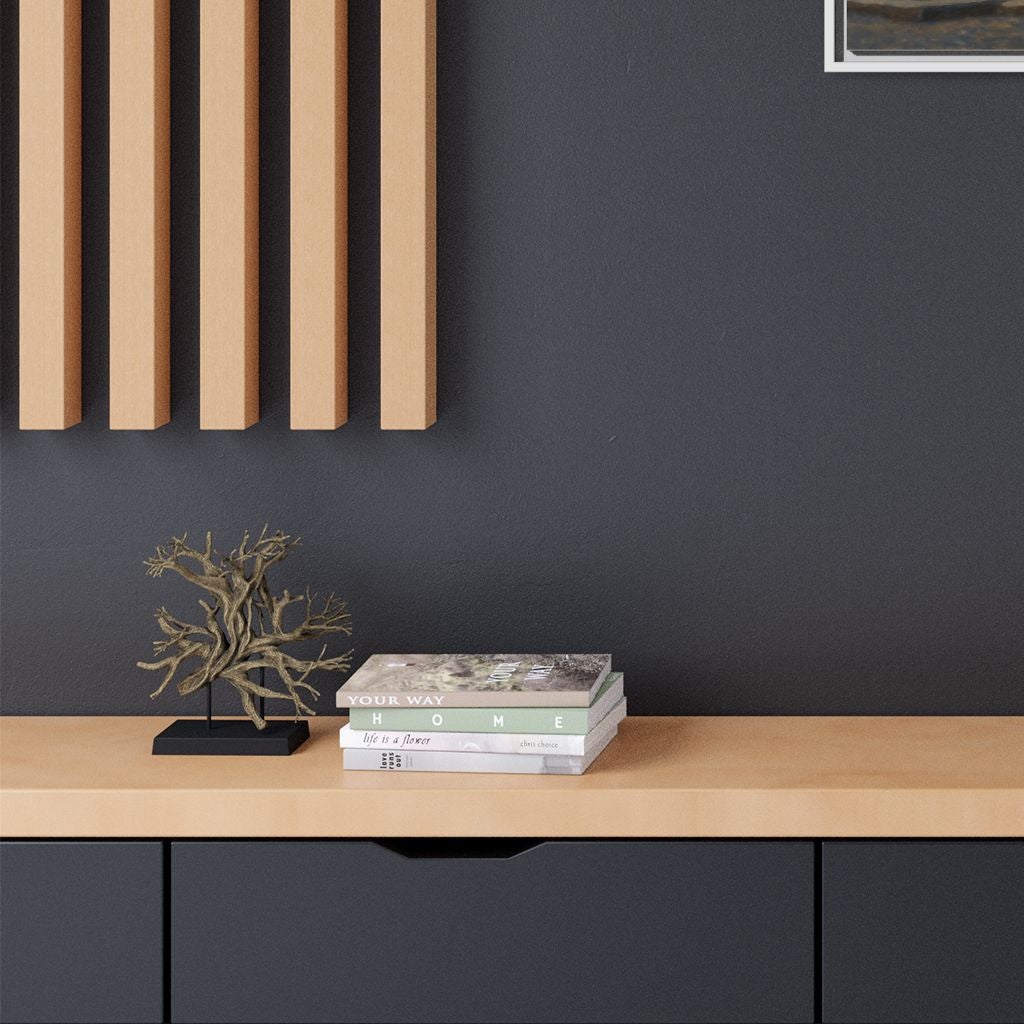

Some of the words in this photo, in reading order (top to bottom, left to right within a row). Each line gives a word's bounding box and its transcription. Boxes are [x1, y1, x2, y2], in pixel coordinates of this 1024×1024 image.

[348, 695, 400, 705] YOUR
[406, 695, 444, 705] WAY
[363, 732, 379, 747] life
[382, 734, 389, 744] is
[400, 733, 431, 747] flower
[380, 752, 388, 769] love
